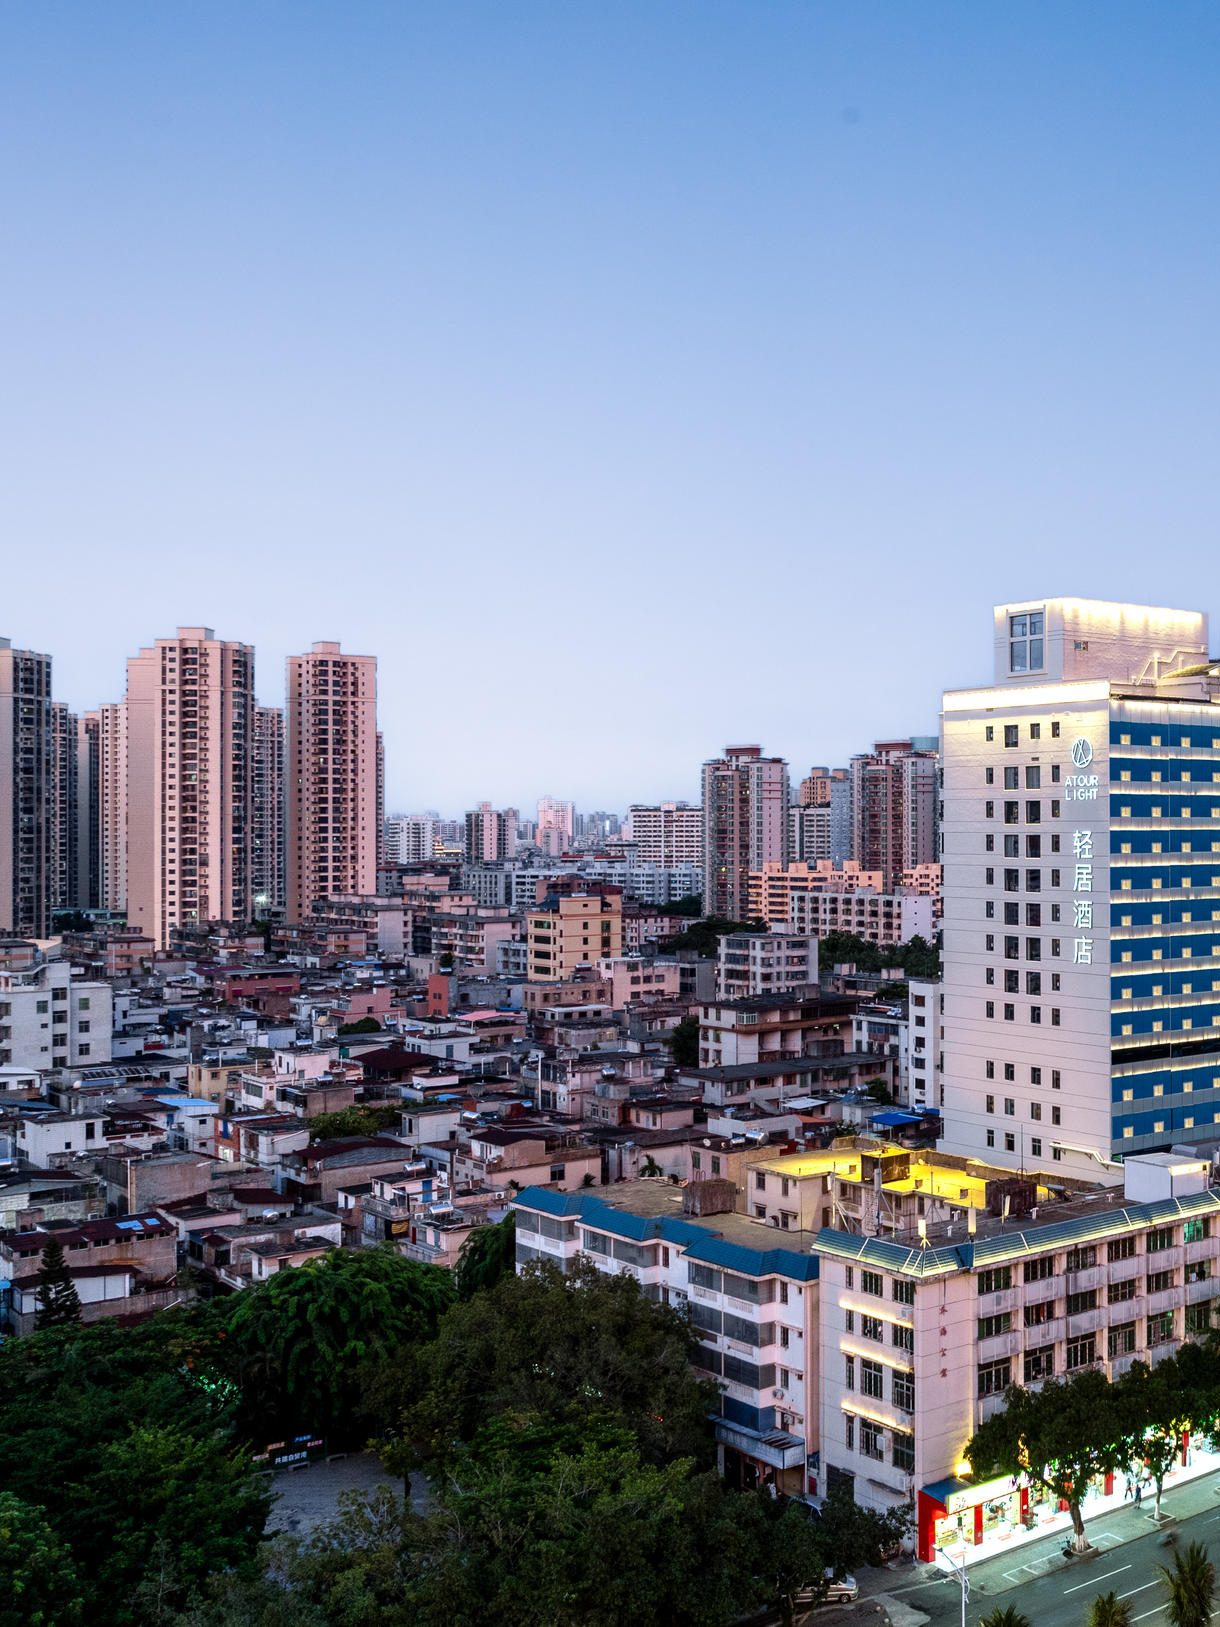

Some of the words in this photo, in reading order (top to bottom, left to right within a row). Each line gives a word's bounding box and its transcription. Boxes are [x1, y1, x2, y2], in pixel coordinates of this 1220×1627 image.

[1065, 775, 1098, 787] ATOUR
[1065, 789, 1098, 801] LIGHT
[1073, 829, 1093, 965] 轻居酒店
